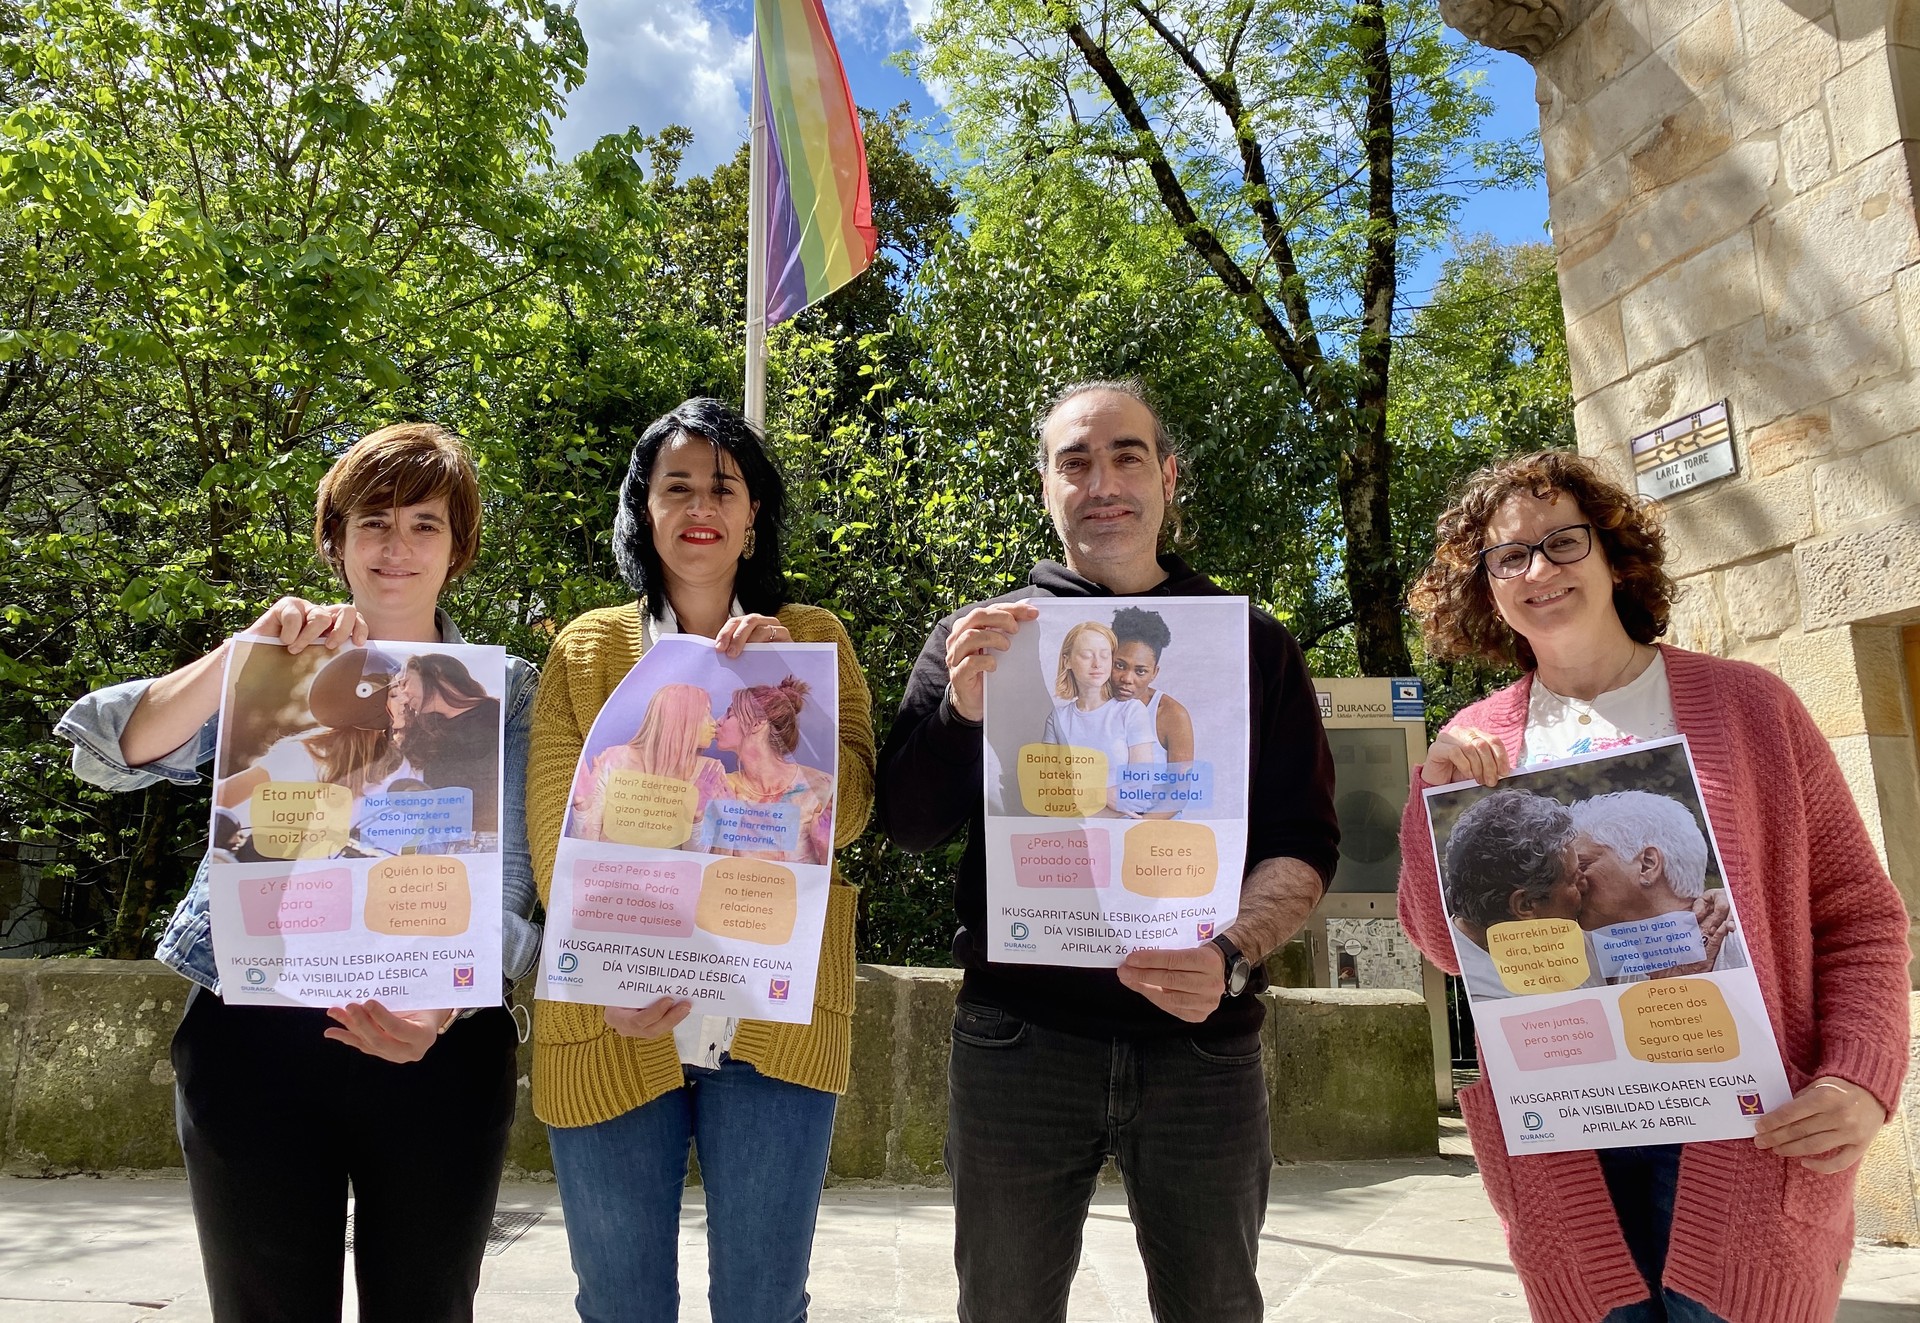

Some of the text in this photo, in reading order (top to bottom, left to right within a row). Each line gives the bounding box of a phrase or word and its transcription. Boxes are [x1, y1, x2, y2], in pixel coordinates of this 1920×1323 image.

[1656, 452, 1710, 481] LARIZ TORRE
[1669, 472, 1697, 490] KALEA
[1337, 704, 1386, 712] DURANGO
[1026, 754, 1095, 767] Baina, gizon
[1039, 770, 1082, 780] batekin
[1122, 770, 1199, 784] Hori seguru
[614, 777, 687, 794] Hori? Ederregia
[1038, 786, 1084, 798] probatu
[262, 788, 336, 801] Eta mutil-
[613, 791, 683, 806] da, nahi dituen
[1120, 788, 1202, 800] bollera dela!
[365, 798, 391, 807] Nork
[395, 798, 433, 808] esango
[1044, 802, 1077, 812] duzu?
[272, 810, 325, 824] laguna
[379, 811, 450, 822] Oso janzkera
[615, 805, 678, 819] gizon guztiak
[723, 805, 783, 820] Lesbianek ez
[367, 825, 462, 837] femeninoa du eta
[616, 819, 673, 832] izan ditzake
[716, 819, 787, 833] dute harreman
[269, 830, 327, 843] noizko?
[1027, 838, 1088, 850] ¿Pero, has
[1150, 846, 1192, 857] Esa es
[1020, 855, 1096, 867] probado con
[380, 865, 456, 880] ¡Quién lo iba
[592, 863, 676, 879] ¿Esa? Pero si es
[716, 870, 786, 885] Las lesbianas
[1135, 864, 1206, 878] bollera fijo
[260, 880, 333, 895] ¿Y el novio
[389, 882, 447, 894] a decir! Si
[725, 887, 773, 899] no tienen
[281, 900, 312, 912] para
[389, 900, 447, 911] viste muy
[584, 893, 674, 910] tener a todos los
[720, 901, 774, 915] relaciones
[268, 916, 326, 929] cuando?
[389, 916, 446, 929] femenina
[571, 906, 682, 927] hombre que quisiese
[1002, 907, 1217, 924] IKUSGARRITASUN LESBIKOAREN EGUNA
[723, 918, 767, 930] estables
[1611, 920, 1677, 936] Baina bi gizon
[1044, 925, 1178, 940] DÍA VISIBILIDAD LÉSBICA
[1492, 924, 1570, 943] Elkarrekin bizi
[1603, 930, 1692, 950] dirudite! Ziur gizon
[559, 938, 793, 971] IKUSGARRITASUN LESBIKOAREN EGUNA
[1061, 943, 1112, 954] APIRILAK
[1115, 945, 1128, 955] 26
[1505, 942, 1565, 957] dira, baina
[1611, 945, 1691, 962] izatea gustatuko
[231, 949, 475, 967] IKUSGARRITASUN LESBIKOAREN EGUNA
[602, 960, 747, 984] DÍA VISIBILIDAD LÉSBICA
[1500, 956, 1579, 975] lagunak baino
[279, 966, 428, 983] DÍA VISIBILIDAD LÉSBICA
[548, 974, 583, 983] DURANGO
[1523, 975, 1564, 987] ez dira.
[299, 986, 409, 998] APIRILAK 26 ABRIL
[618, 981, 726, 1001] APIRILAK 26 ABRIL
[1647, 983, 1688, 999] ¡Pero si
[1637, 998, 1707, 1016] parecen dos
[1522, 1016, 1589, 1030] Viven juntas,
[1649, 1014, 1703, 1028] hombres!
[1524, 1031, 1594, 1047] pero son sólo
[1639, 1029, 1724, 1046] Seguro que les
[1544, 1047, 1583, 1058] amigas
[1646, 1044, 1725, 1063] gustaría serlo
[1510, 1074, 1757, 1105] IKUSGARRITASUN LESBIKOAREN EGUNA
[1559, 1095, 1711, 1119] DÍA VISIBILIDAD LÉSBICA
[1582, 1115, 1697, 1134] APIRILAK 26 ABRIL
[1520, 1132, 1555, 1141] DURANGO
